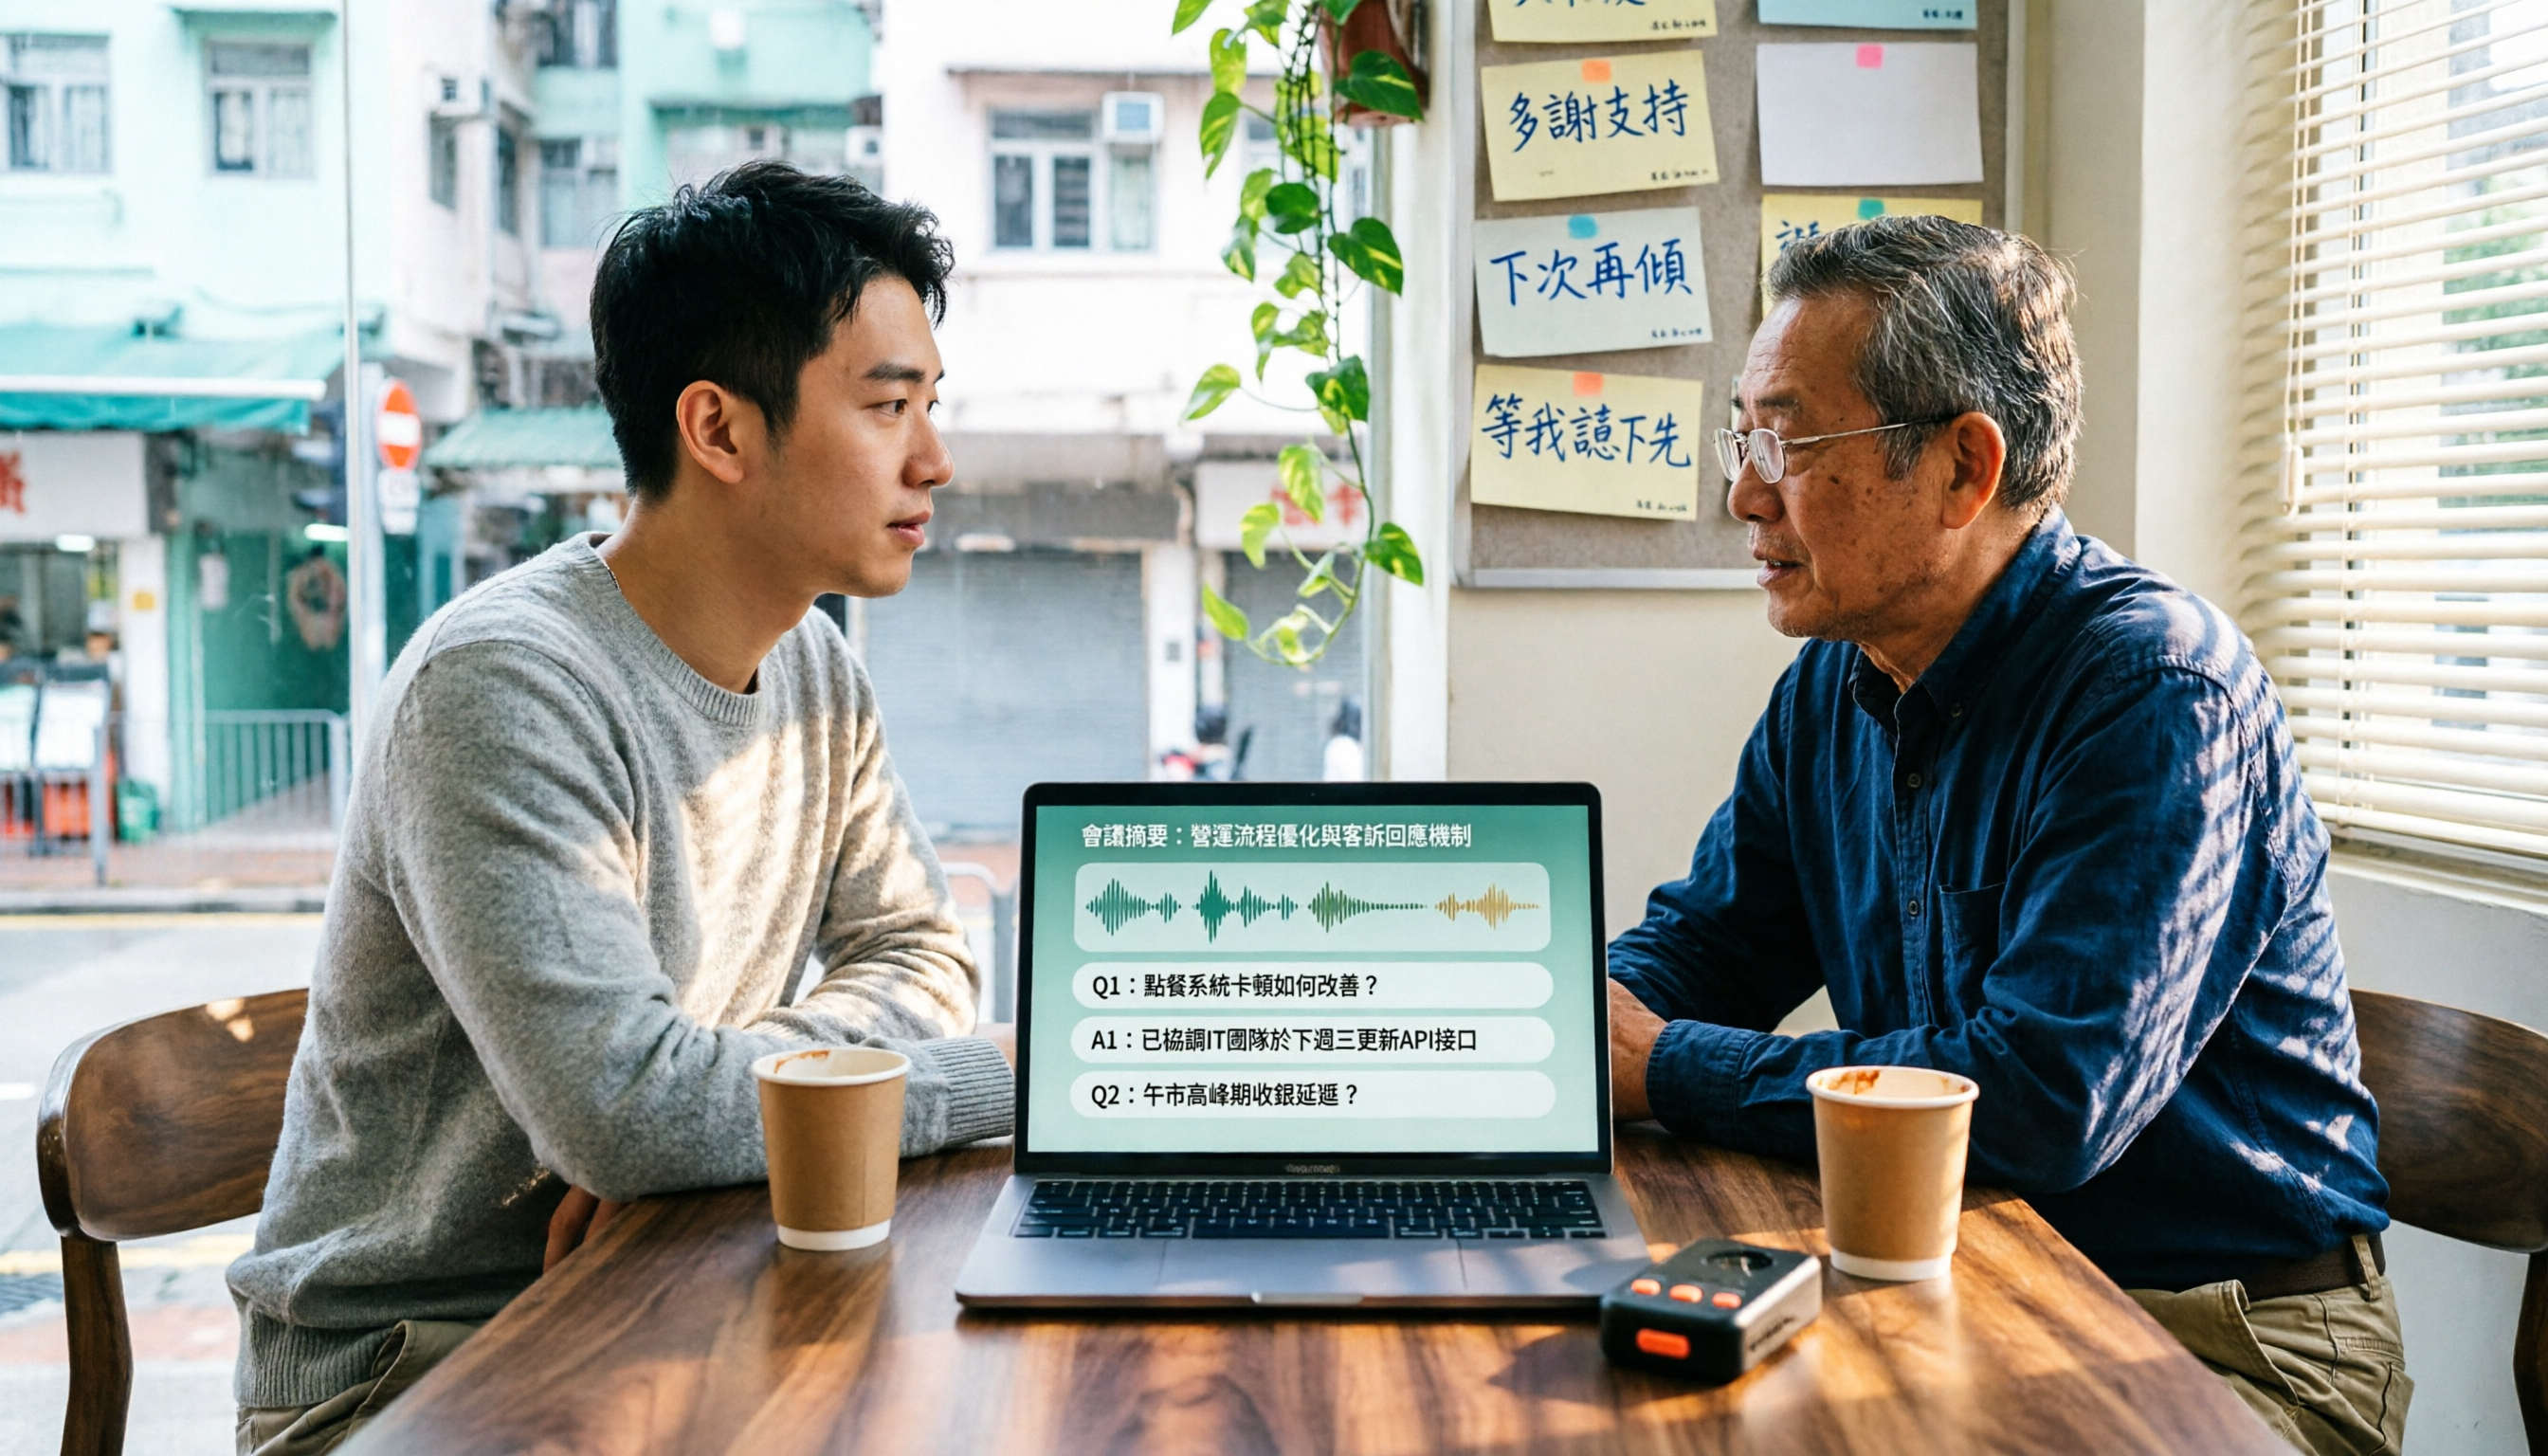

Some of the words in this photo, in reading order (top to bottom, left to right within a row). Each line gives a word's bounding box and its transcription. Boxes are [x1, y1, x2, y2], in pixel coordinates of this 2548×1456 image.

[1511, 80, 1688, 153] 多謝支持
[1490, 238, 1692, 305] 下次再傾
